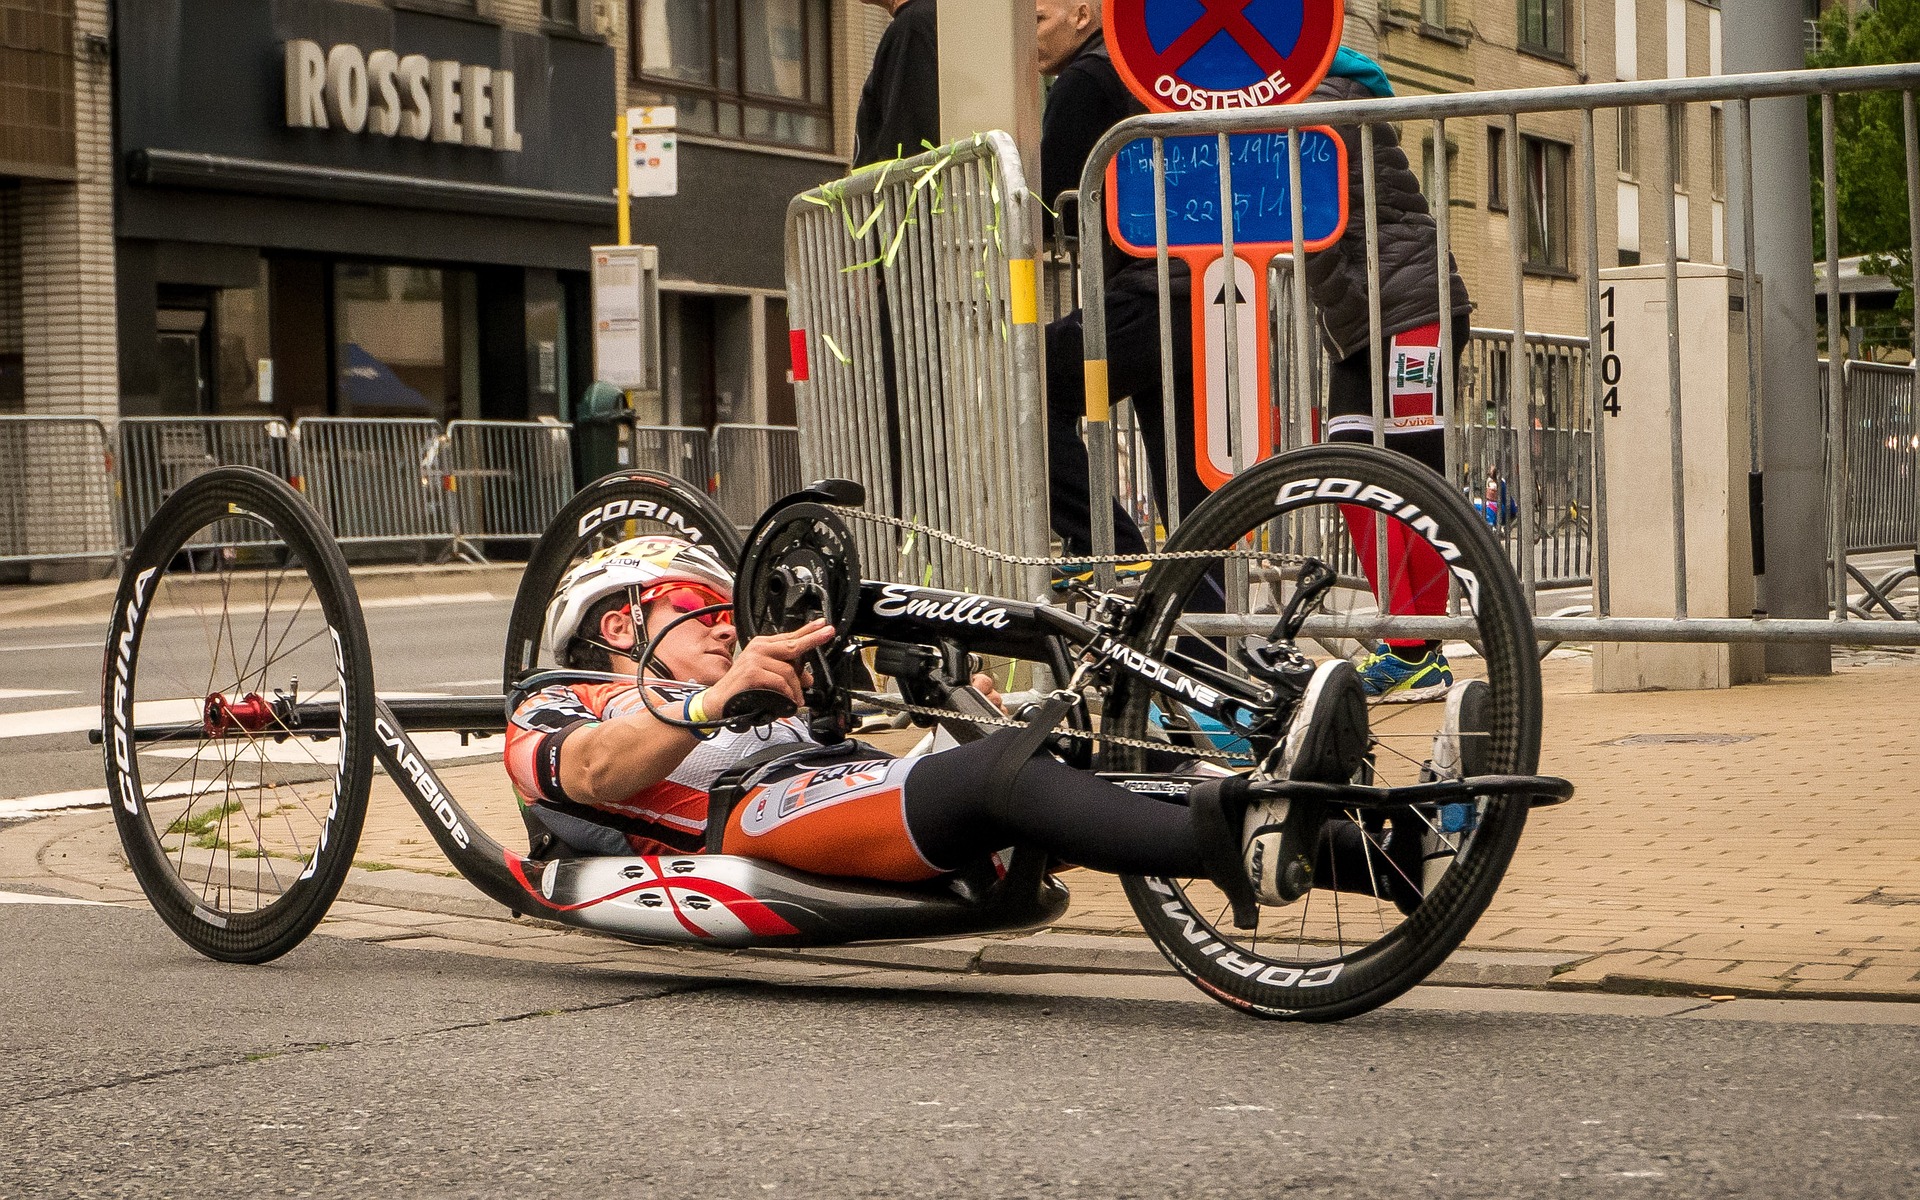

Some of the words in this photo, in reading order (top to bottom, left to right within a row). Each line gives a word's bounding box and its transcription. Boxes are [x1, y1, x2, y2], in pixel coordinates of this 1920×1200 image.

[284, 38, 524, 152] ROSSEEL
[1154, 69, 1292, 111] OOSTENDE
[1601, 286, 1622, 418] 1104
[577, 499, 704, 544] CORIM
[1274, 477, 1480, 618] CORIMA
[873, 584, 1010, 630] Emilia
[112, 566, 157, 816] CORIMA
[1101, 638, 1220, 708] MADDILINE
[299, 624, 348, 881] CORIMA
[375, 717, 470, 851] CARBIDE
